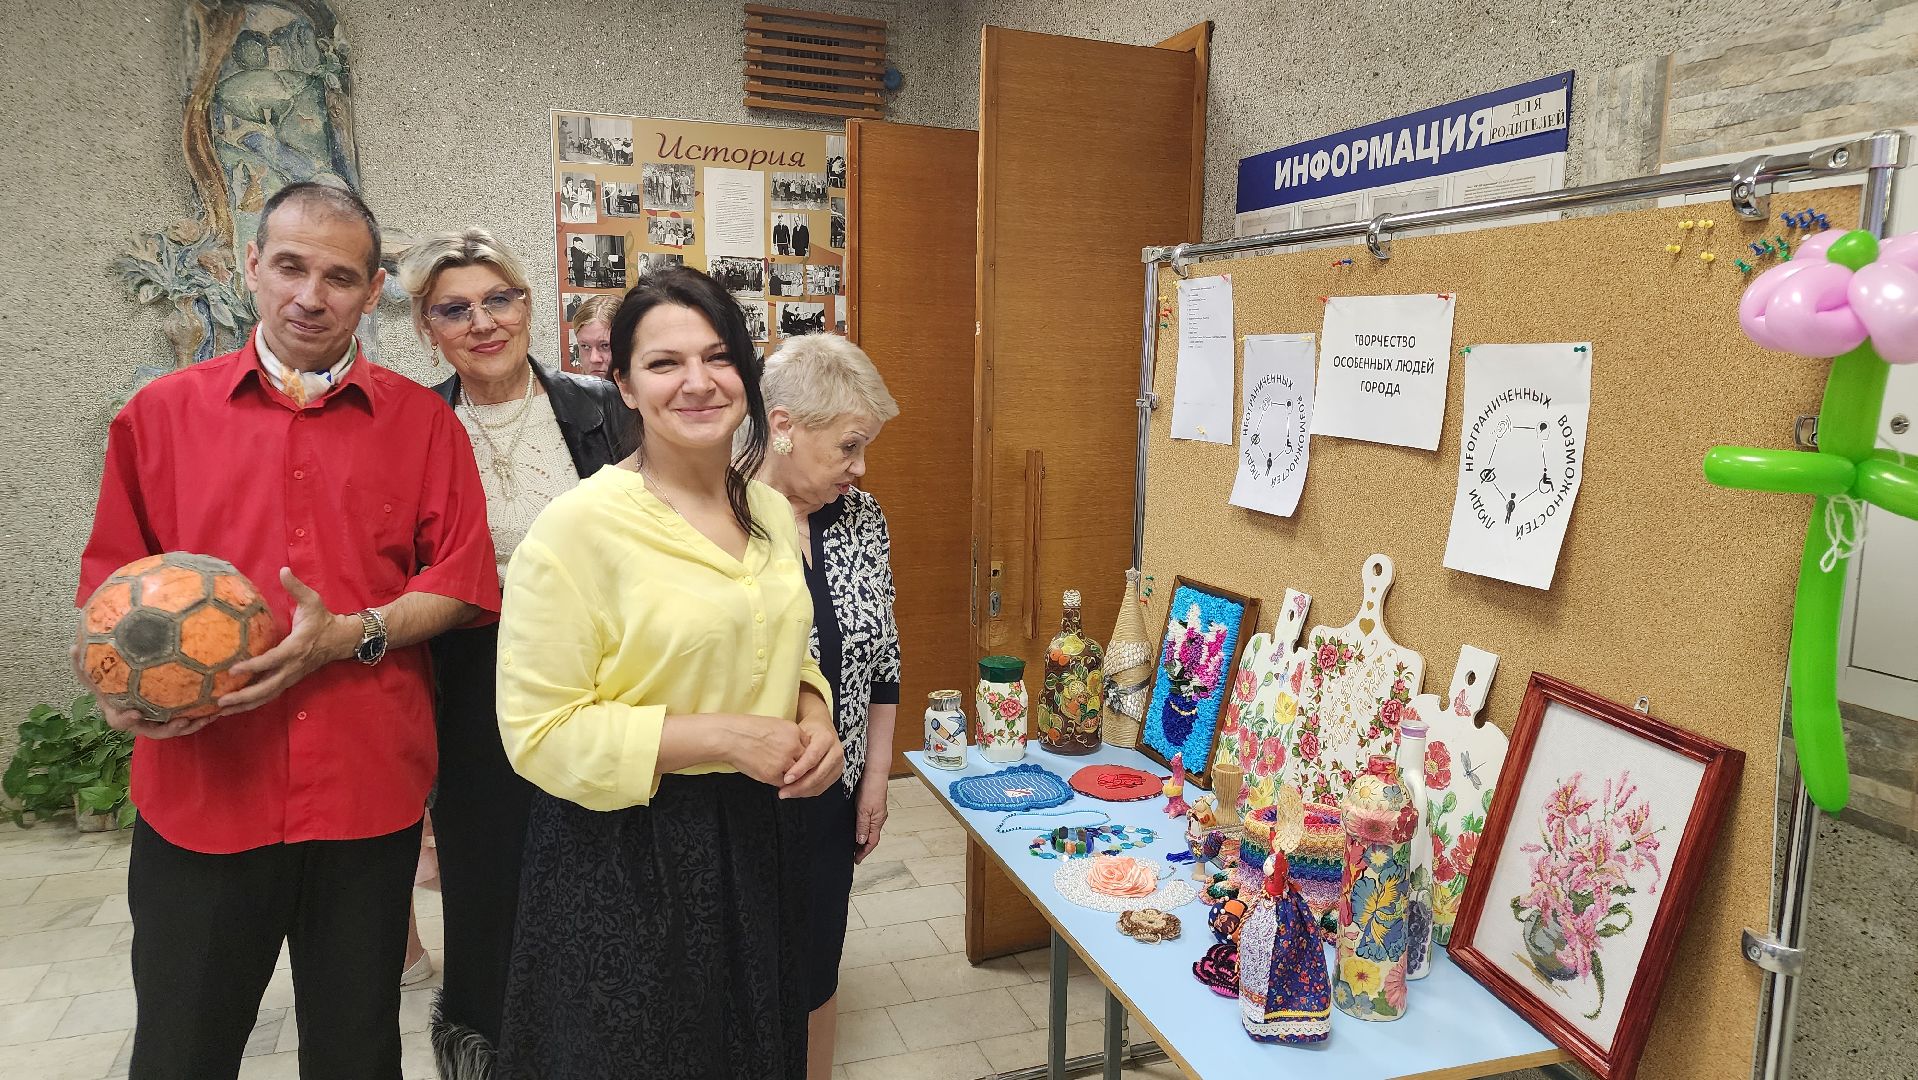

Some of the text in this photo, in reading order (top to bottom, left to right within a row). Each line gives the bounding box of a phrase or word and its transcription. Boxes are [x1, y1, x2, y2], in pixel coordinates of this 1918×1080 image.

[1512, 97, 1542, 118] ДЛЯ
[1491, 108, 1565, 140] РОДИТЕЛЕЙ
[655, 132, 806, 170] История
[1274, 107, 1492, 190] ИНФОРМАЦИЯ
[1354, 334, 1416, 348] ТВОРЧЕСТВО
[1333, 355, 1435, 375] ОСОБЕННЫХ ЛЮДЕЙ
[1360, 380, 1401, 397] ГОРОДА
[1242, 373, 1306, 489] ЛЮДИ НЕОГРАНИЧЕННЫХ ВОЗМОЖНОСТЕЙ
[1465, 387, 1576, 541] ЛЮДИ НЕОГРАНИЧЕННЫХ ВОЗМОЖНОСТЕЙ
